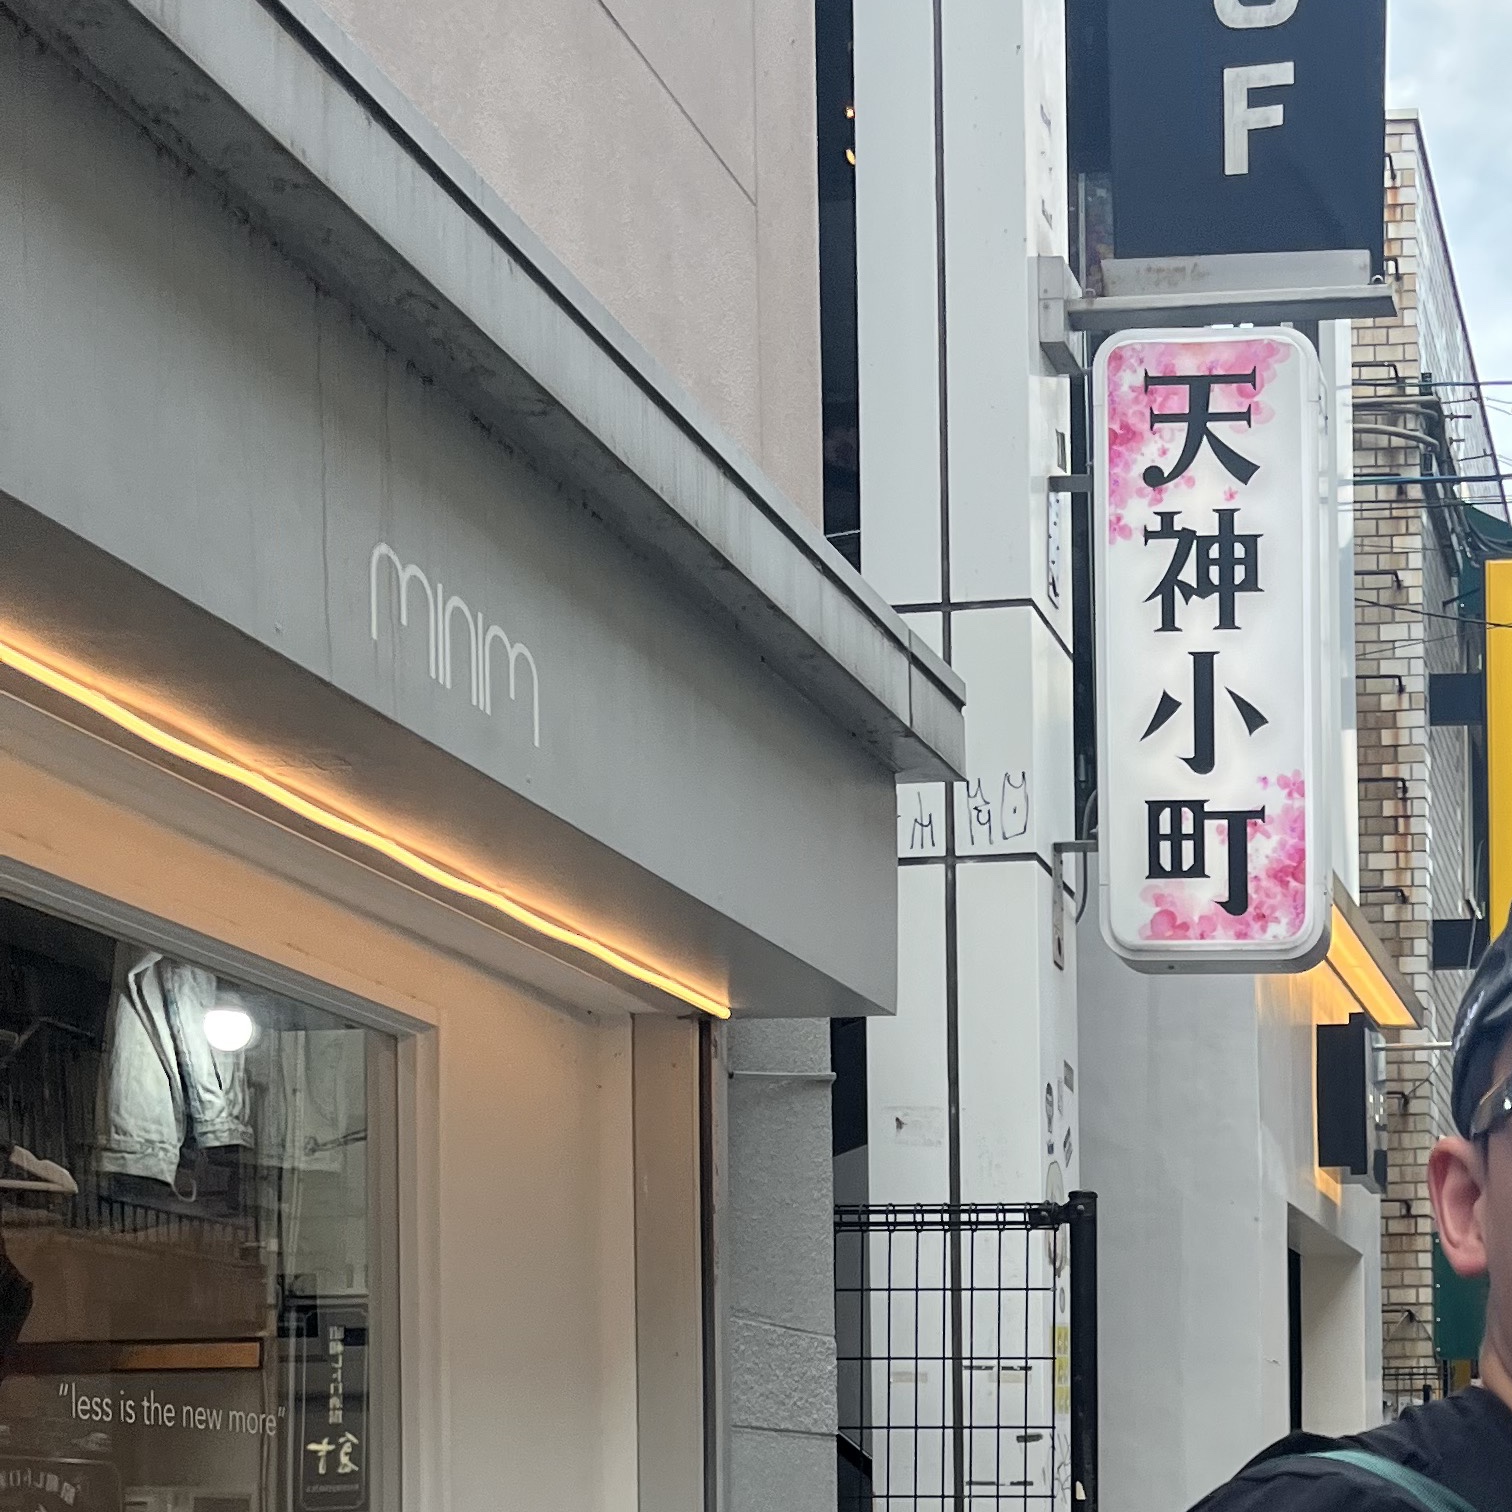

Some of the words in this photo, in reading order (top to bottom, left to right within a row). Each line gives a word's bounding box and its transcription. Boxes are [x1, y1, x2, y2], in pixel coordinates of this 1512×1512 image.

[1139, 366, 1268, 916] 天神小町
[119, 1389, 136, 1424] is
[141, 1389, 175, 1427] the
[182, 1405, 222, 1431] new
